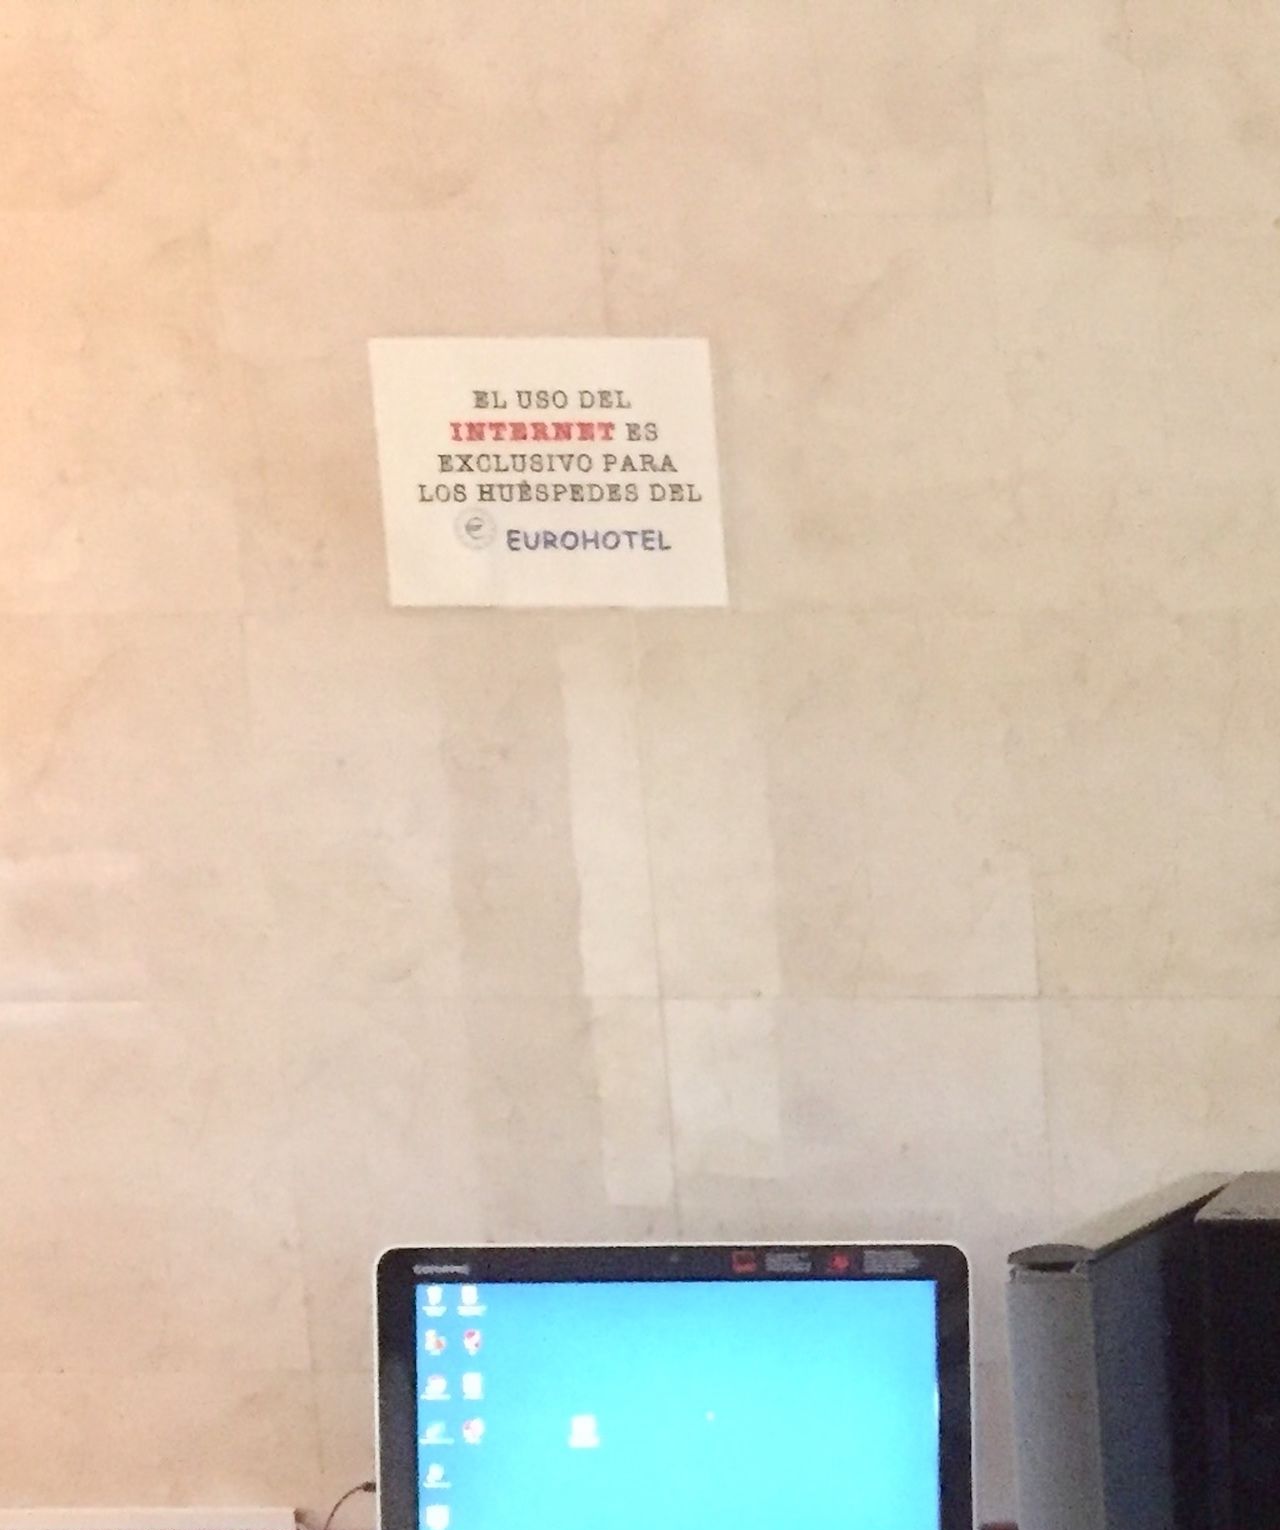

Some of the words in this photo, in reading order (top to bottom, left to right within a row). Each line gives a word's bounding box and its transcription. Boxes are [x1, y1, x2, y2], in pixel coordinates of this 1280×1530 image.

[472, 389, 508, 410] EL
[515, 389, 569, 410] USO
[578, 389, 632, 410] DEL
[449, 421, 616, 442] INTERNET
[624, 422, 659, 442] ES
[437, 453, 593, 473] EXCLUSIVO
[602, 453, 679, 473] PARA
[418, 483, 468, 504] LOS
[476, 479, 639, 503] HUÉSPEDES
[648, 482, 703, 503] DEL
[506, 528, 672, 552] EUROHOTEL
